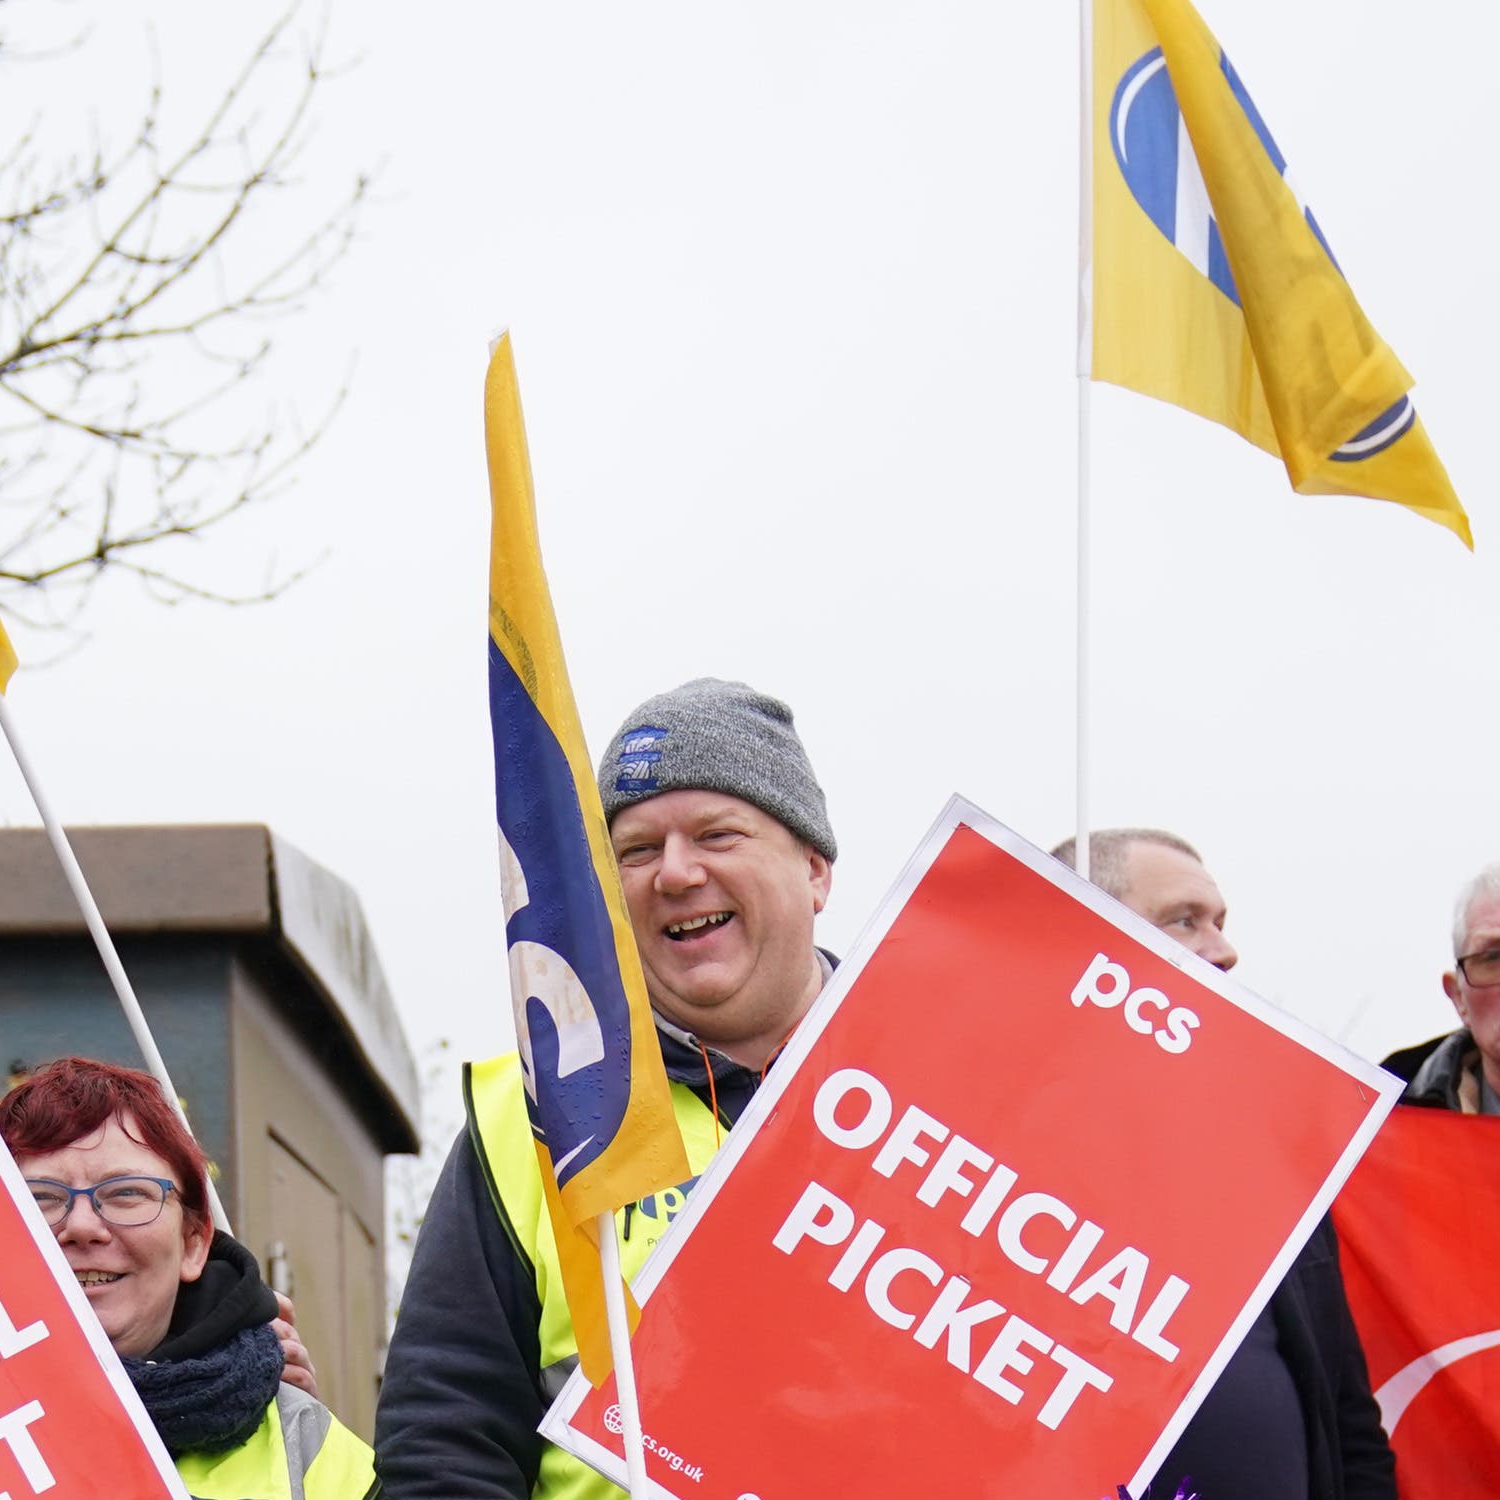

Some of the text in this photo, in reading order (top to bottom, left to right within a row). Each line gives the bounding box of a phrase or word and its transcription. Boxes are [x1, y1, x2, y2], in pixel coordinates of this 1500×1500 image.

[1071, 953, 1200, 1053] pcs
[813, 1068, 1190, 1363] OFFICIAL
[773, 1181, 1114, 1431] PICKET
[641, 1433, 704, 1483] cs.org.uk
